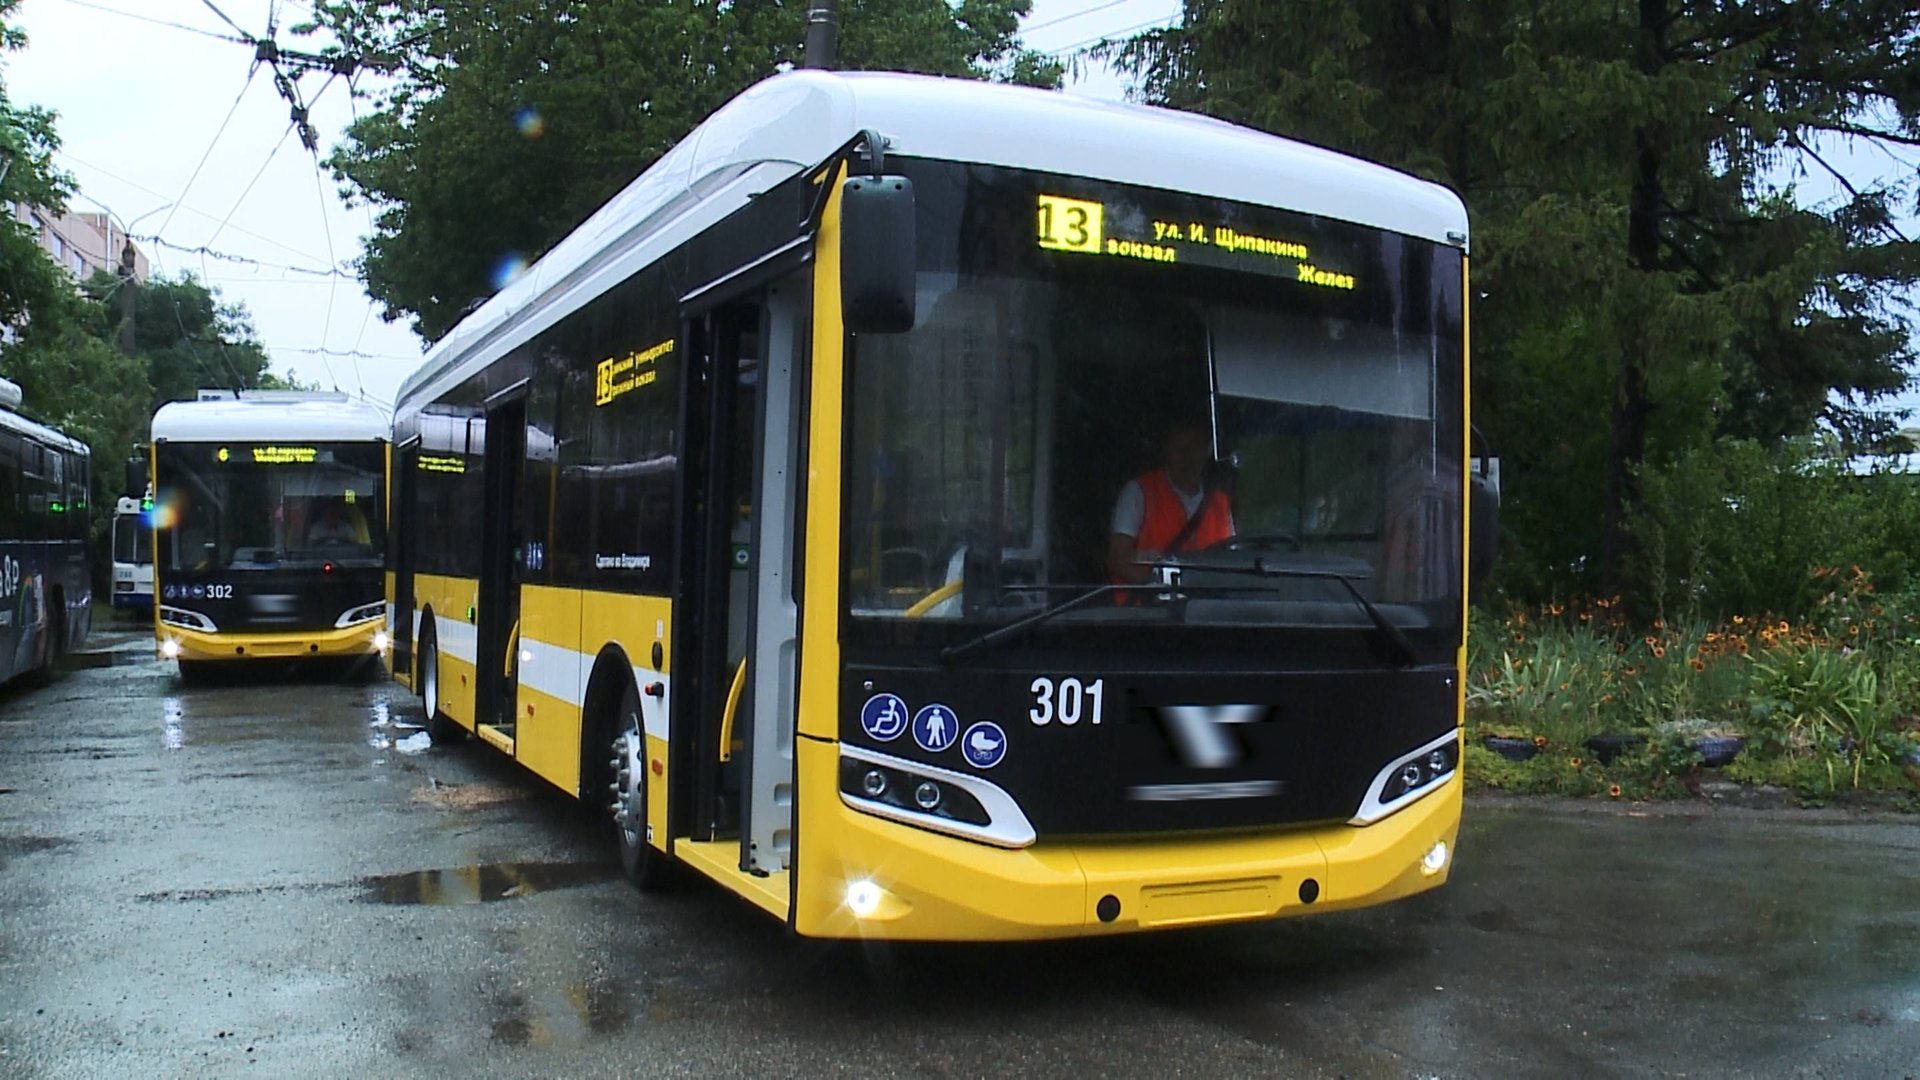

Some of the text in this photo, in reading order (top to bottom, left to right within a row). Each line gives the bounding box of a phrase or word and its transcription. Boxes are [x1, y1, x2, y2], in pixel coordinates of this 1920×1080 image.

[1036, 198, 1092, 250] 13
[1153, 220, 1309, 260] ул. И. Щипакина
[1107, 238, 1176, 262] вокзал
[1296, 262, 1355, 289] Желез
[597, 360, 612, 403] 13
[218, 447, 229, 462] 6
[206, 584, 233, 599] 302
[1029, 677, 1105, 727] 301
